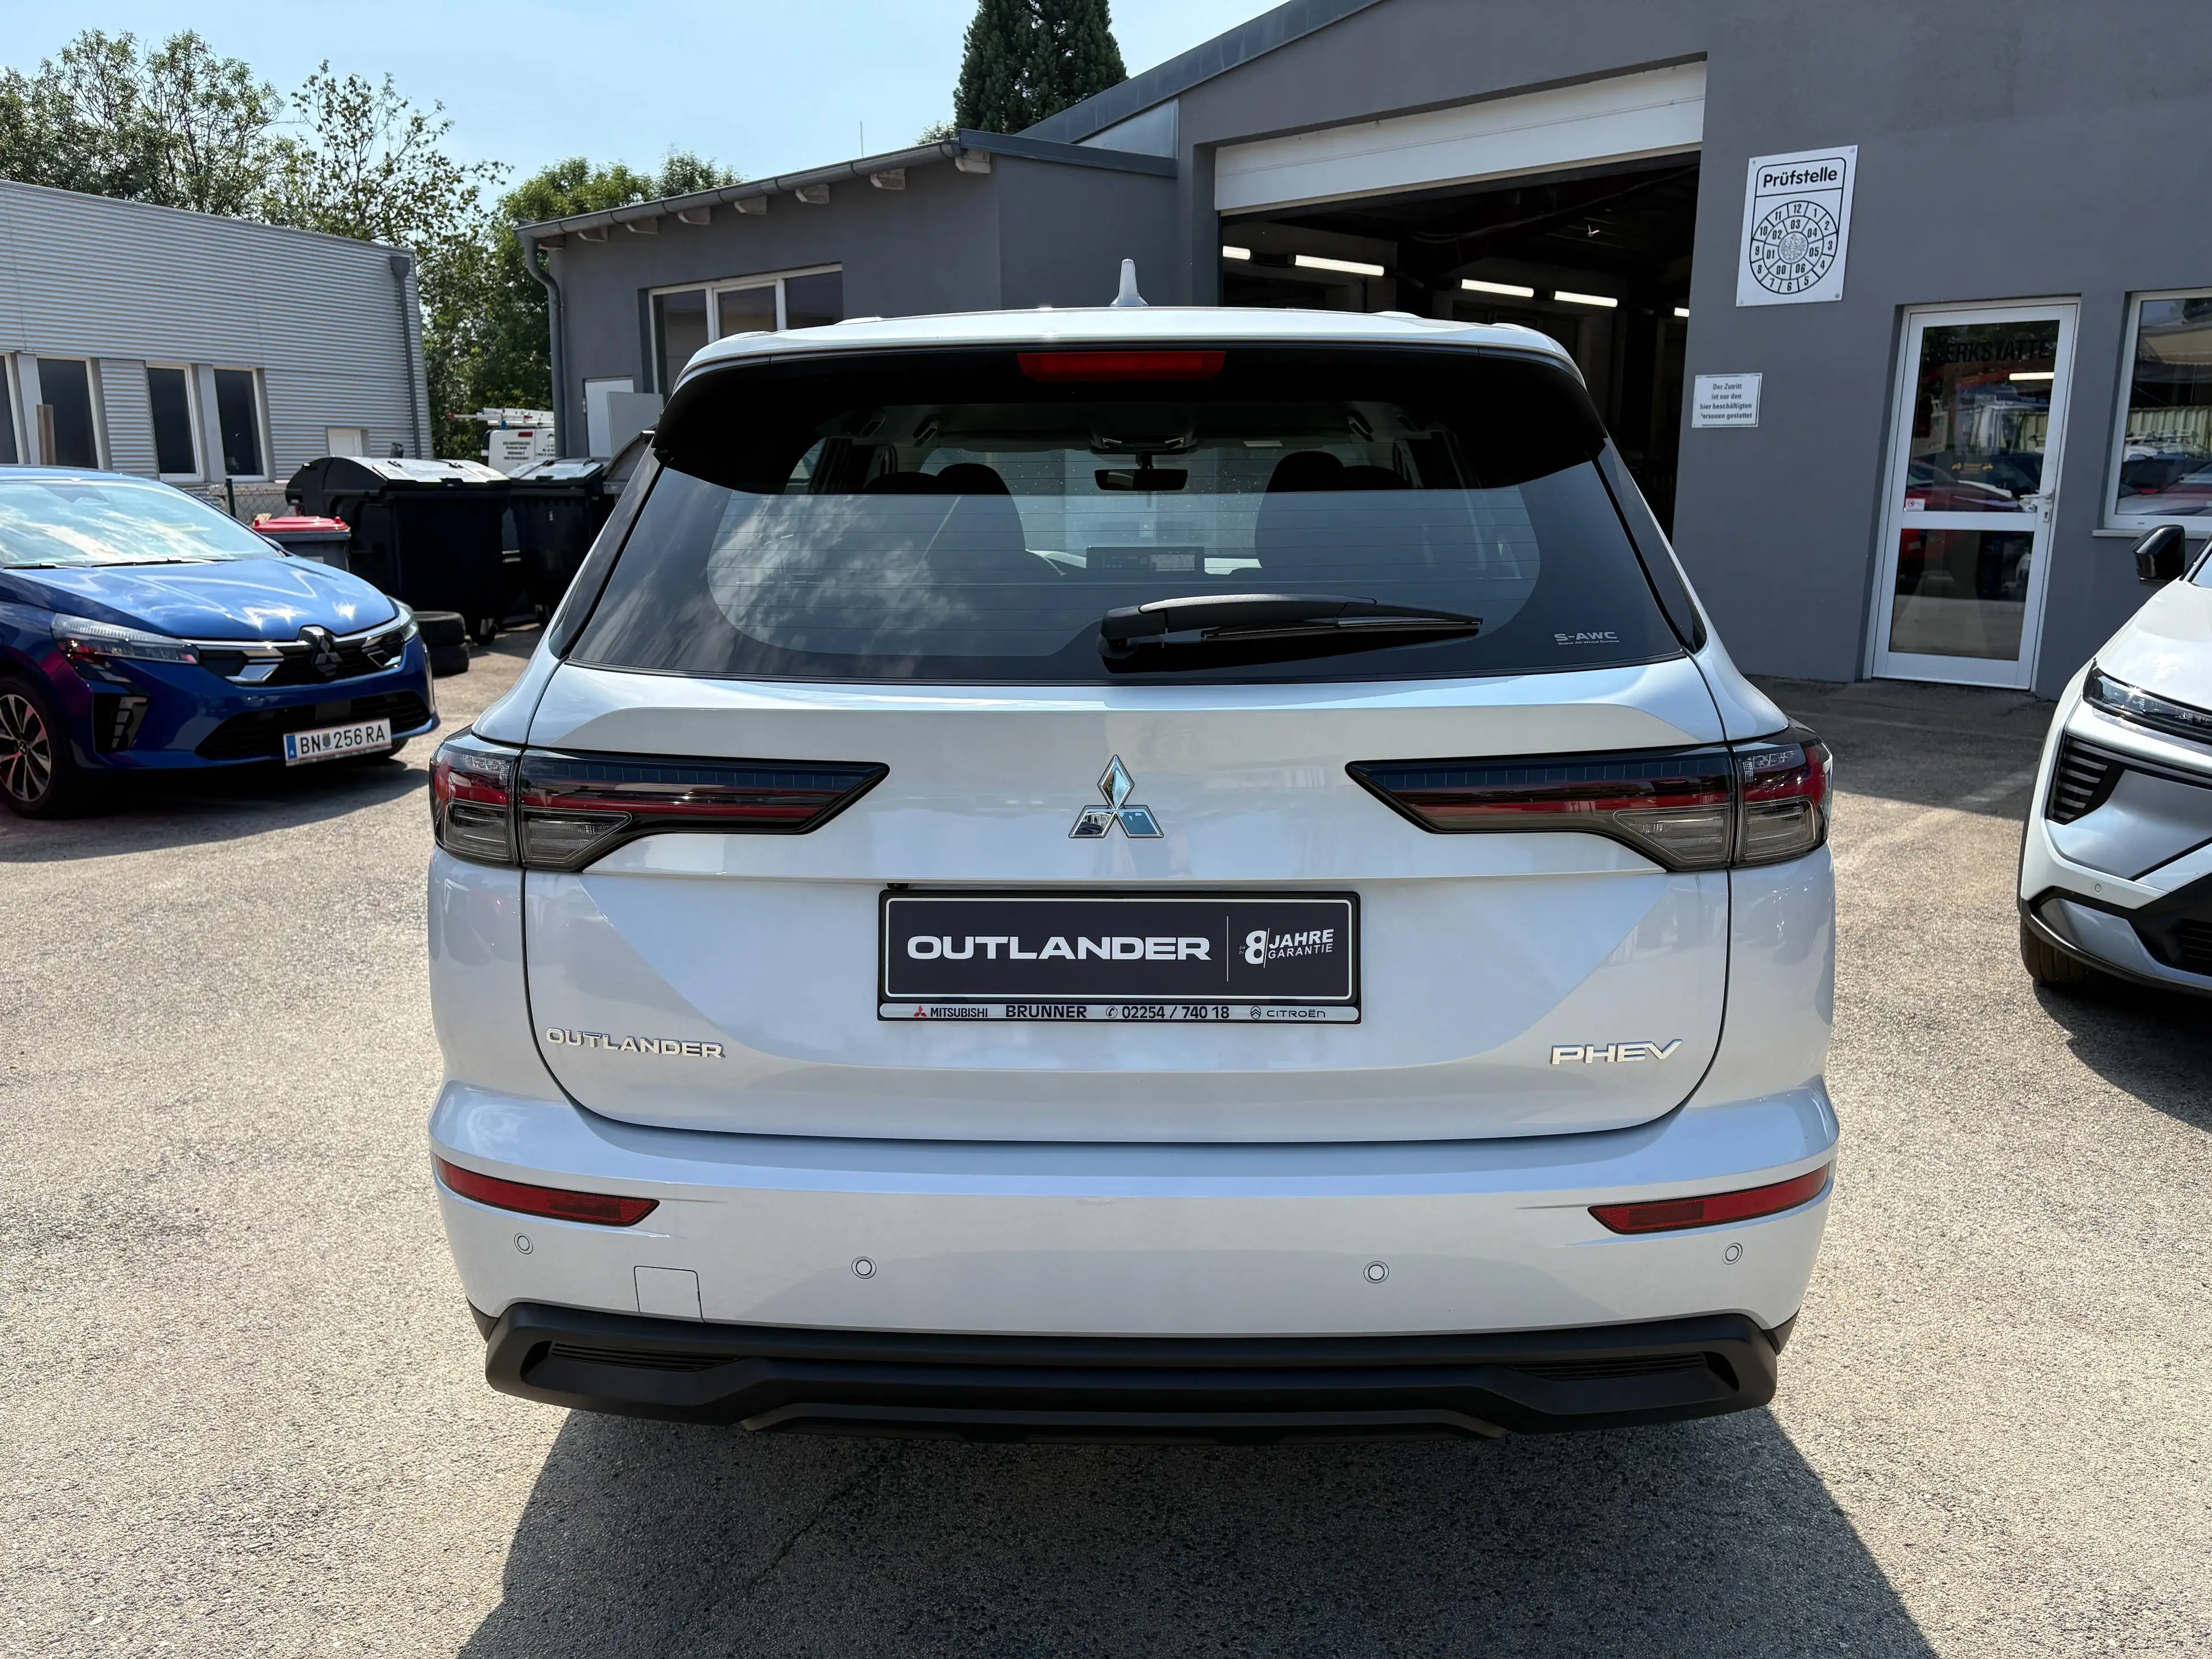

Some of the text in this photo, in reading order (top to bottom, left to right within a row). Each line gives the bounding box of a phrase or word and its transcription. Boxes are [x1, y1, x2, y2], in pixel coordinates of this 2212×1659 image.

[1763, 166, 1838, 188] Prüfstelle
[1793, 203, 1802, 214] 12
[1813, 207, 1817, 218] 1
[1775, 211, 1782, 221] 11
[1790, 219, 1801, 229] 03
[1824, 221, 1830, 230] 2
[1760, 226, 1768, 236] 10
[1772, 230, 1782, 240] 02
[1807, 228, 1817, 238] 04
[1755, 246, 1760, 256] 9
[1828, 241, 1833, 251] 3
[1766, 249, 1775, 259] 01
[1809, 247, 1820, 257] 05
[1758, 264, 1762, 274] 8
[1777, 265, 1786, 275] 00
[1796, 263, 1806, 274] 06
[1820, 260, 1825, 270] 4
[1770, 278, 1775, 288] 7
[1804, 276, 1809, 286] 5
[1787, 282, 1792, 291] 6
[1554, 632, 1618, 641] S-AWC
[300, 724, 385, 755] BN 256 RA
[1268, 929, 1334, 949] JAHRE
[907, 935, 1212, 960] OUTLANDER
[1245, 930, 1267, 964] 8
[1268, 943, 1333, 959] GARANTIE
[930, 1007, 988, 1018] MITSUBISHI
[1005, 1005, 1088, 1018] BRUNNER
[1122, 1006, 1165, 1019] 02254
[1181, 1006, 1207, 1019] 740
[1212, 1006, 1229, 1019] 18
[546, 1027, 726, 1058] OUTLANDER
[1550, 1039, 1683, 1065] PHEV
